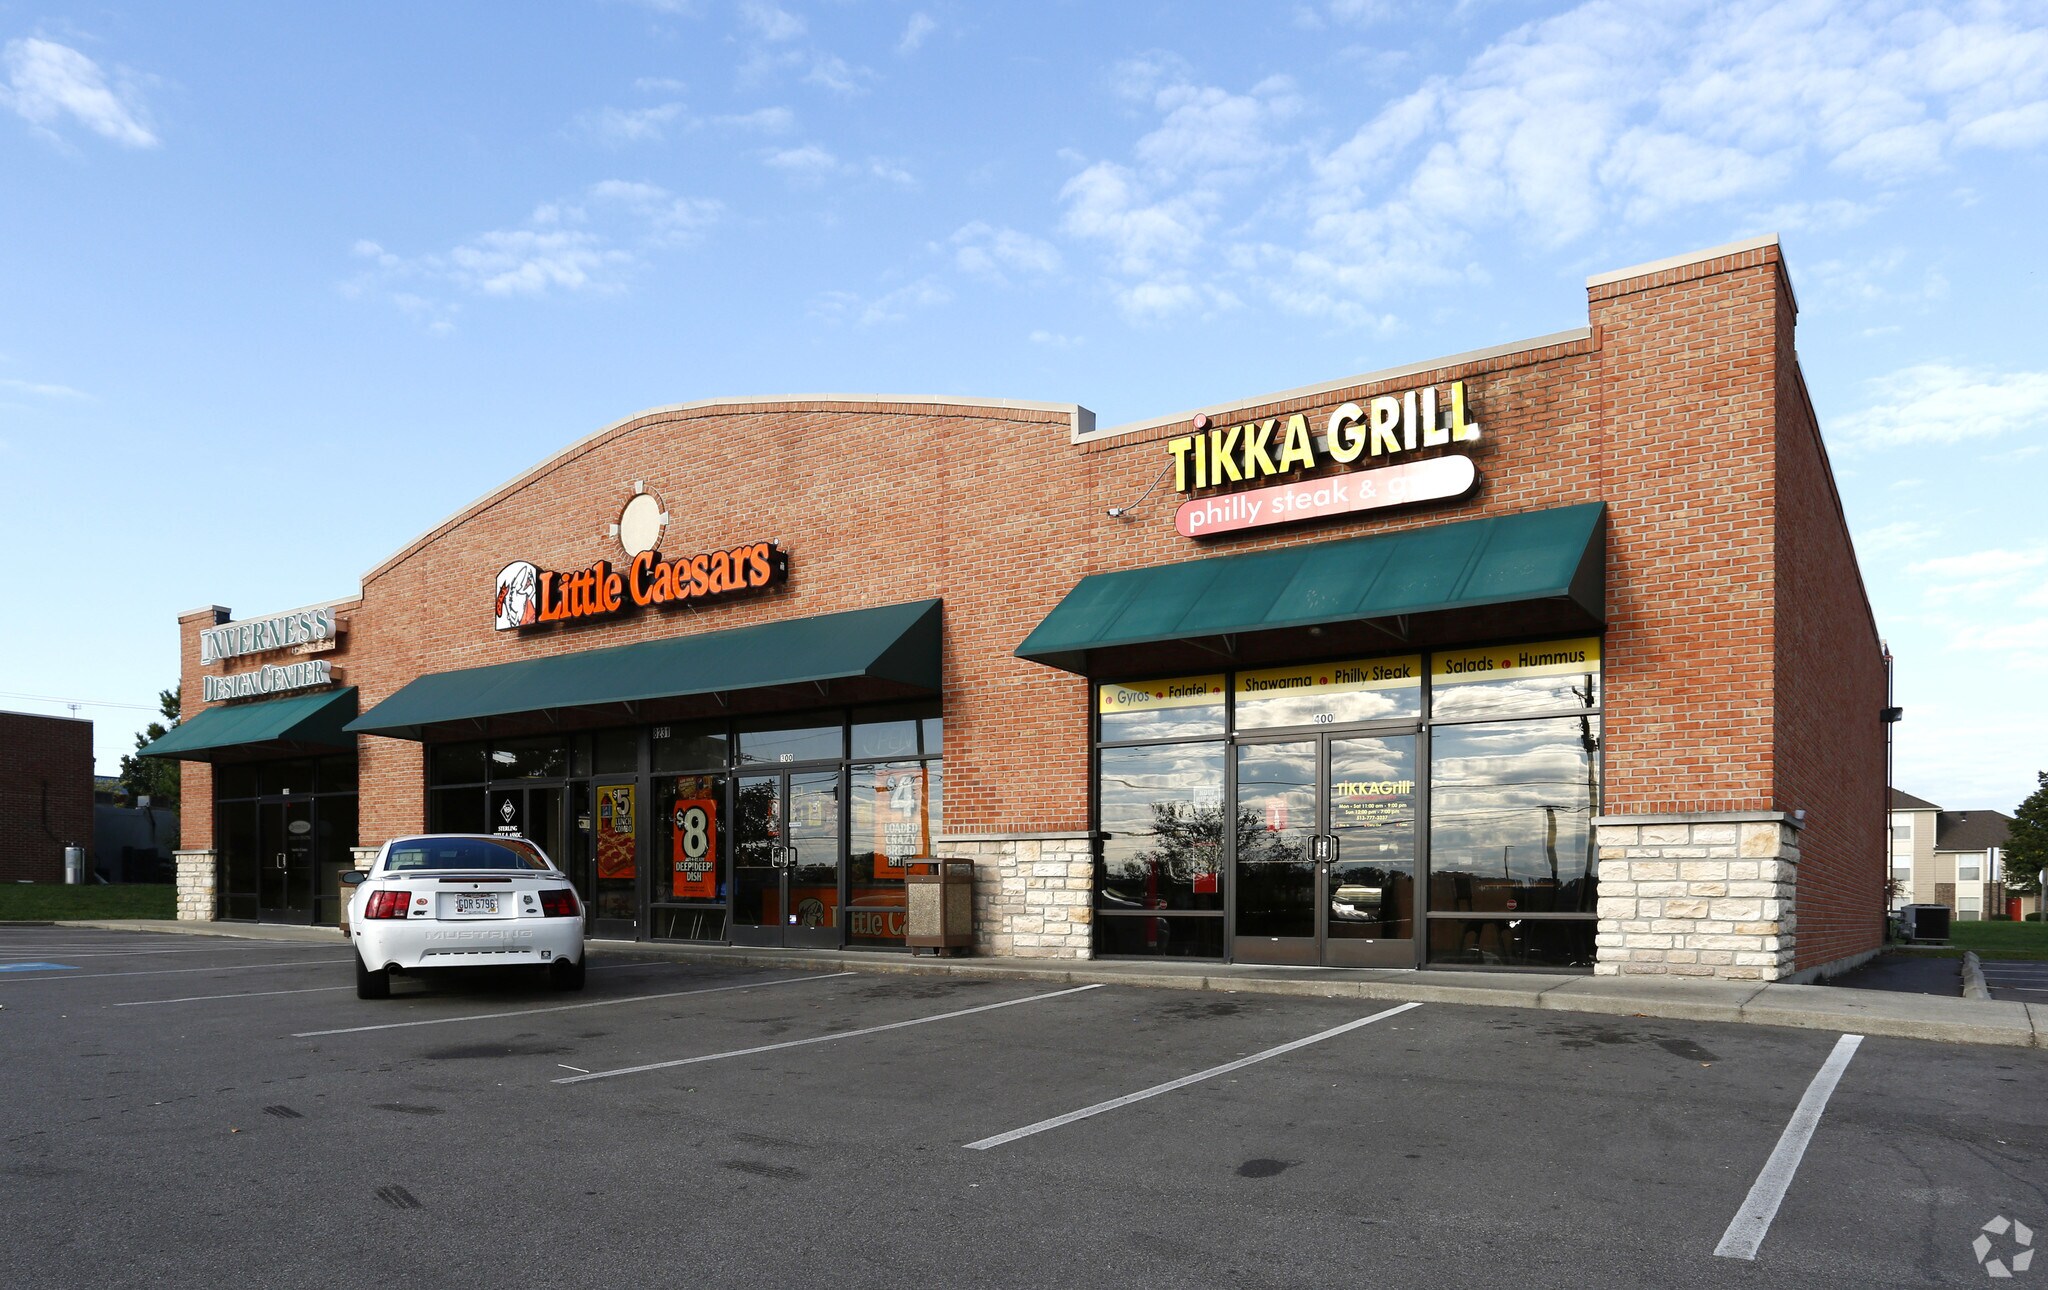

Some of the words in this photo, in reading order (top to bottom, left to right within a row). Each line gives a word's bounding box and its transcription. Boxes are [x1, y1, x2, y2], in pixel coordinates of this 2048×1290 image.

[1326, 381, 1481, 463] GRILL
[1189, 495, 1263, 533] philly
[1271, 480, 1349, 514] steak
[1358, 480, 1378, 499] &
[537, 560, 623, 622] Little
[630, 543, 771, 606] Caesars
[201, 607, 334, 665] INVERNESS
[1445, 656, 1494, 674] Salads
[1518, 650, 1586, 668] Hummus
[1245, 675, 1312, 692] Shawarma
[1334, 668, 1369, 685] Philly
[1372, 664, 1411, 681] Steak
[1117, 689, 1150, 706] Gyros
[1168, 683, 1207, 699] Falafel
[1314, 713, 1334, 724] 400
[615, 817, 632, 825] LUNCH
[884, 823, 918, 834] LOADED
[885, 834, 916, 845] CRAZY
[886, 845, 916, 857] BREAD
[686, 872, 702, 881] DISH
[475, 898, 495, 909] 5796
[425, 929, 533, 941] MUSTANG
